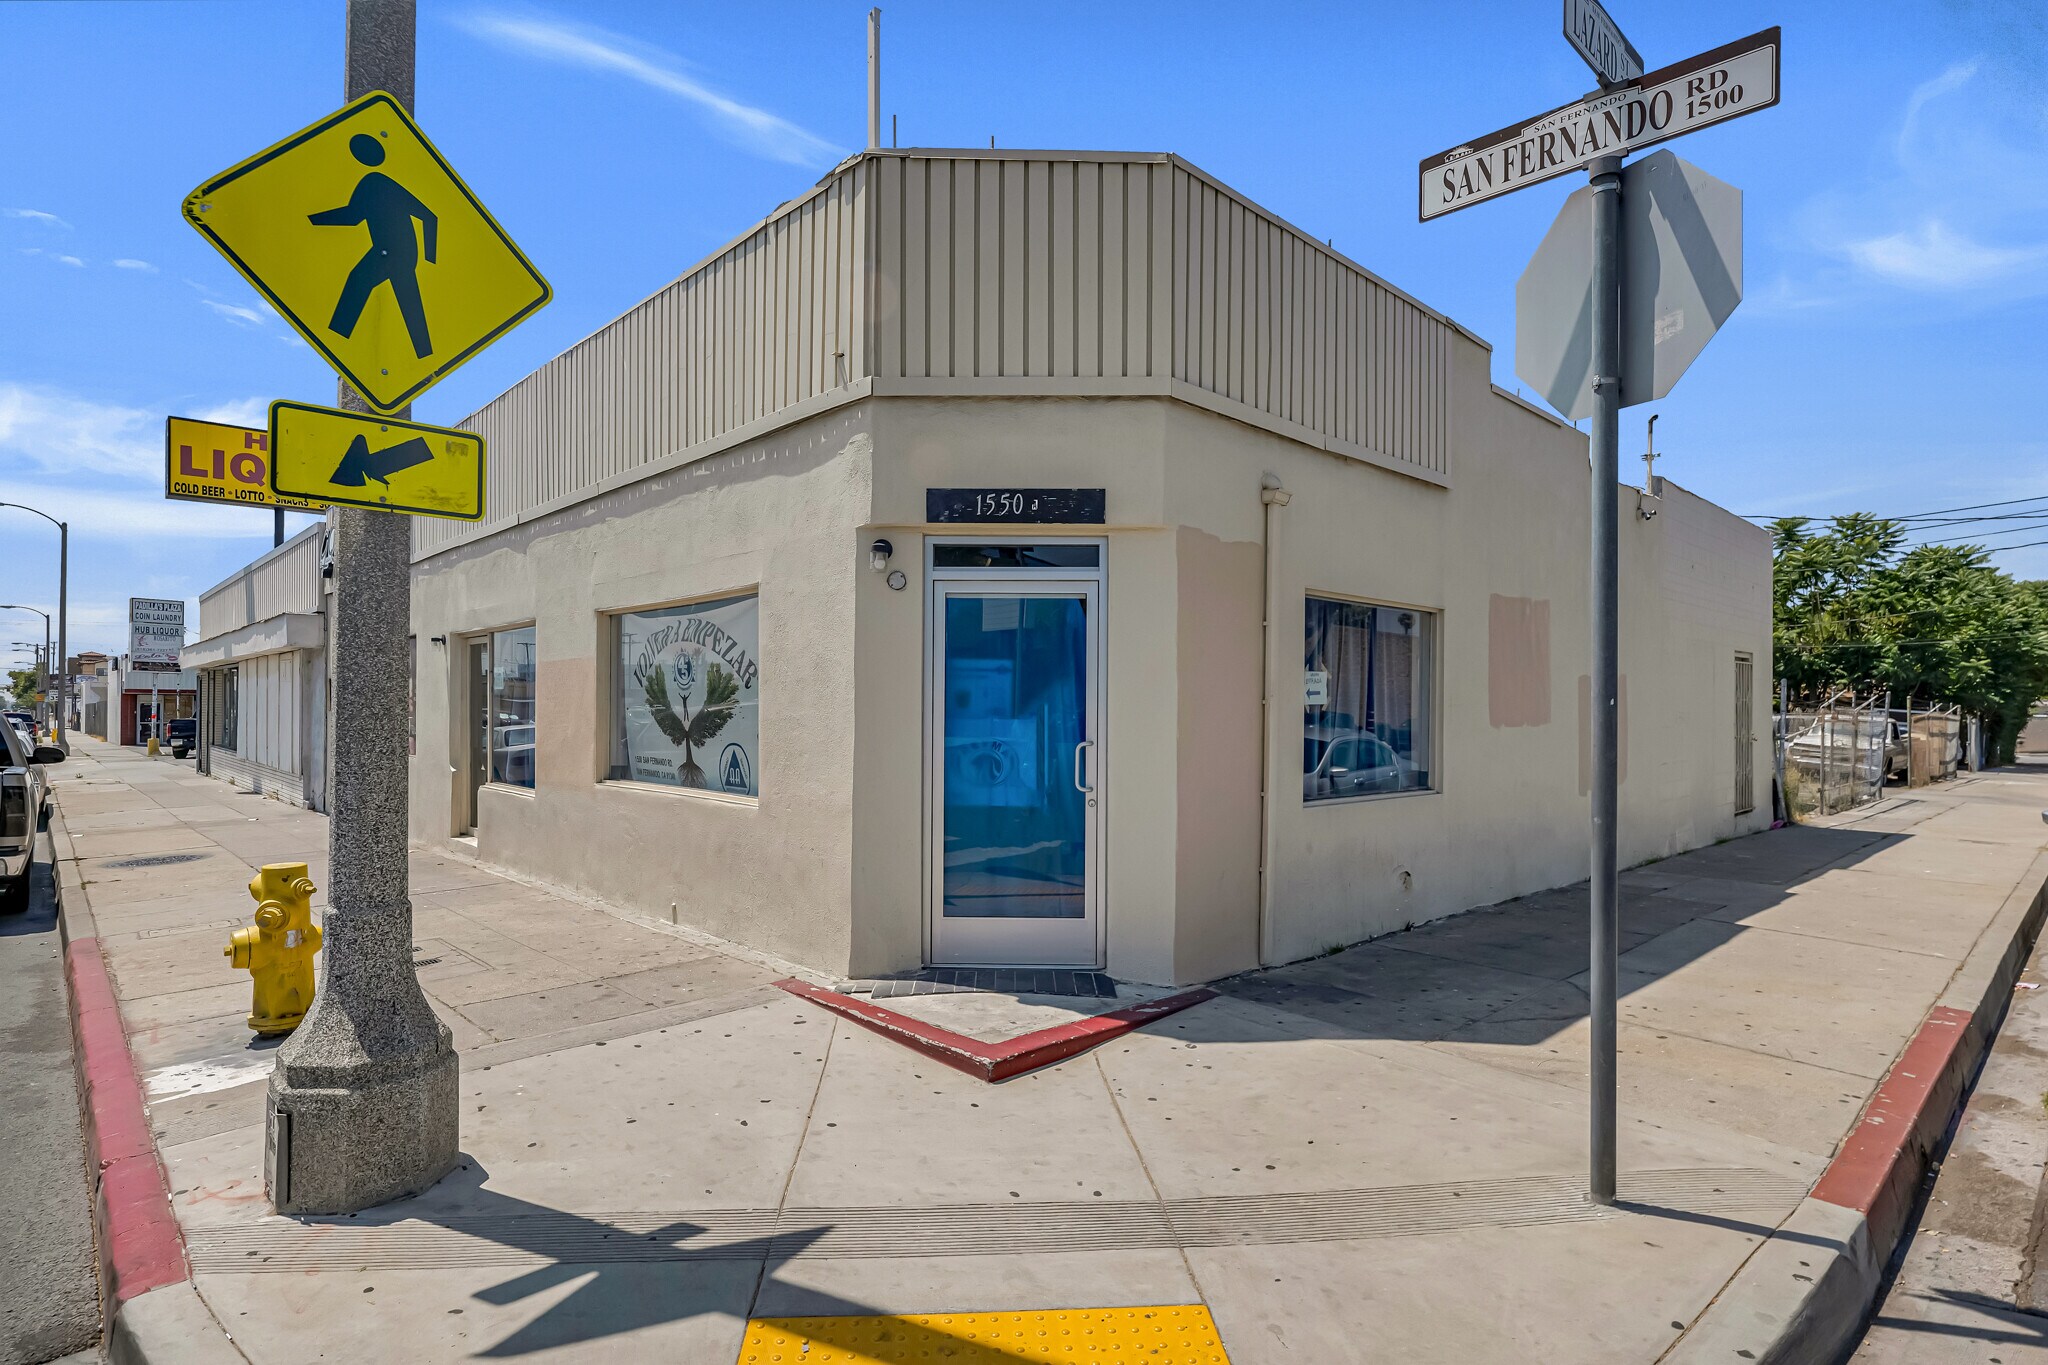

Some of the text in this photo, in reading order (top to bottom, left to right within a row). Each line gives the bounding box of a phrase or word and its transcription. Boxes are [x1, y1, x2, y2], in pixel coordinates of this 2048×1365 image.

[1573, 0, 1618, 82] LAZARD
[1620, 52, 1631, 77] ST
[1686, 68, 1729, 98] RD
[1533, 93, 1627, 133] SAN FERNANDO
[1686, 84, 1744, 120] 1500
[1442, 89, 1674, 204] SAN FERNANDO
[180, 444, 267, 488] LIQ
[174, 481, 199, 495] COLD
[202, 485, 225, 498] BEER
[235, 488, 265, 502] LOTTO
[976, 493, 1023, 516] 1550
[135, 612, 181, 622] COIN LAUNDRY
[164, 603, 182, 612] PLAZA
[135, 626, 179, 636] HUB LIQUOR
[634, 625, 674, 688] VOLVER
[681, 618, 758, 690] EMPEZAR
[729, 767, 741, 785] AA
